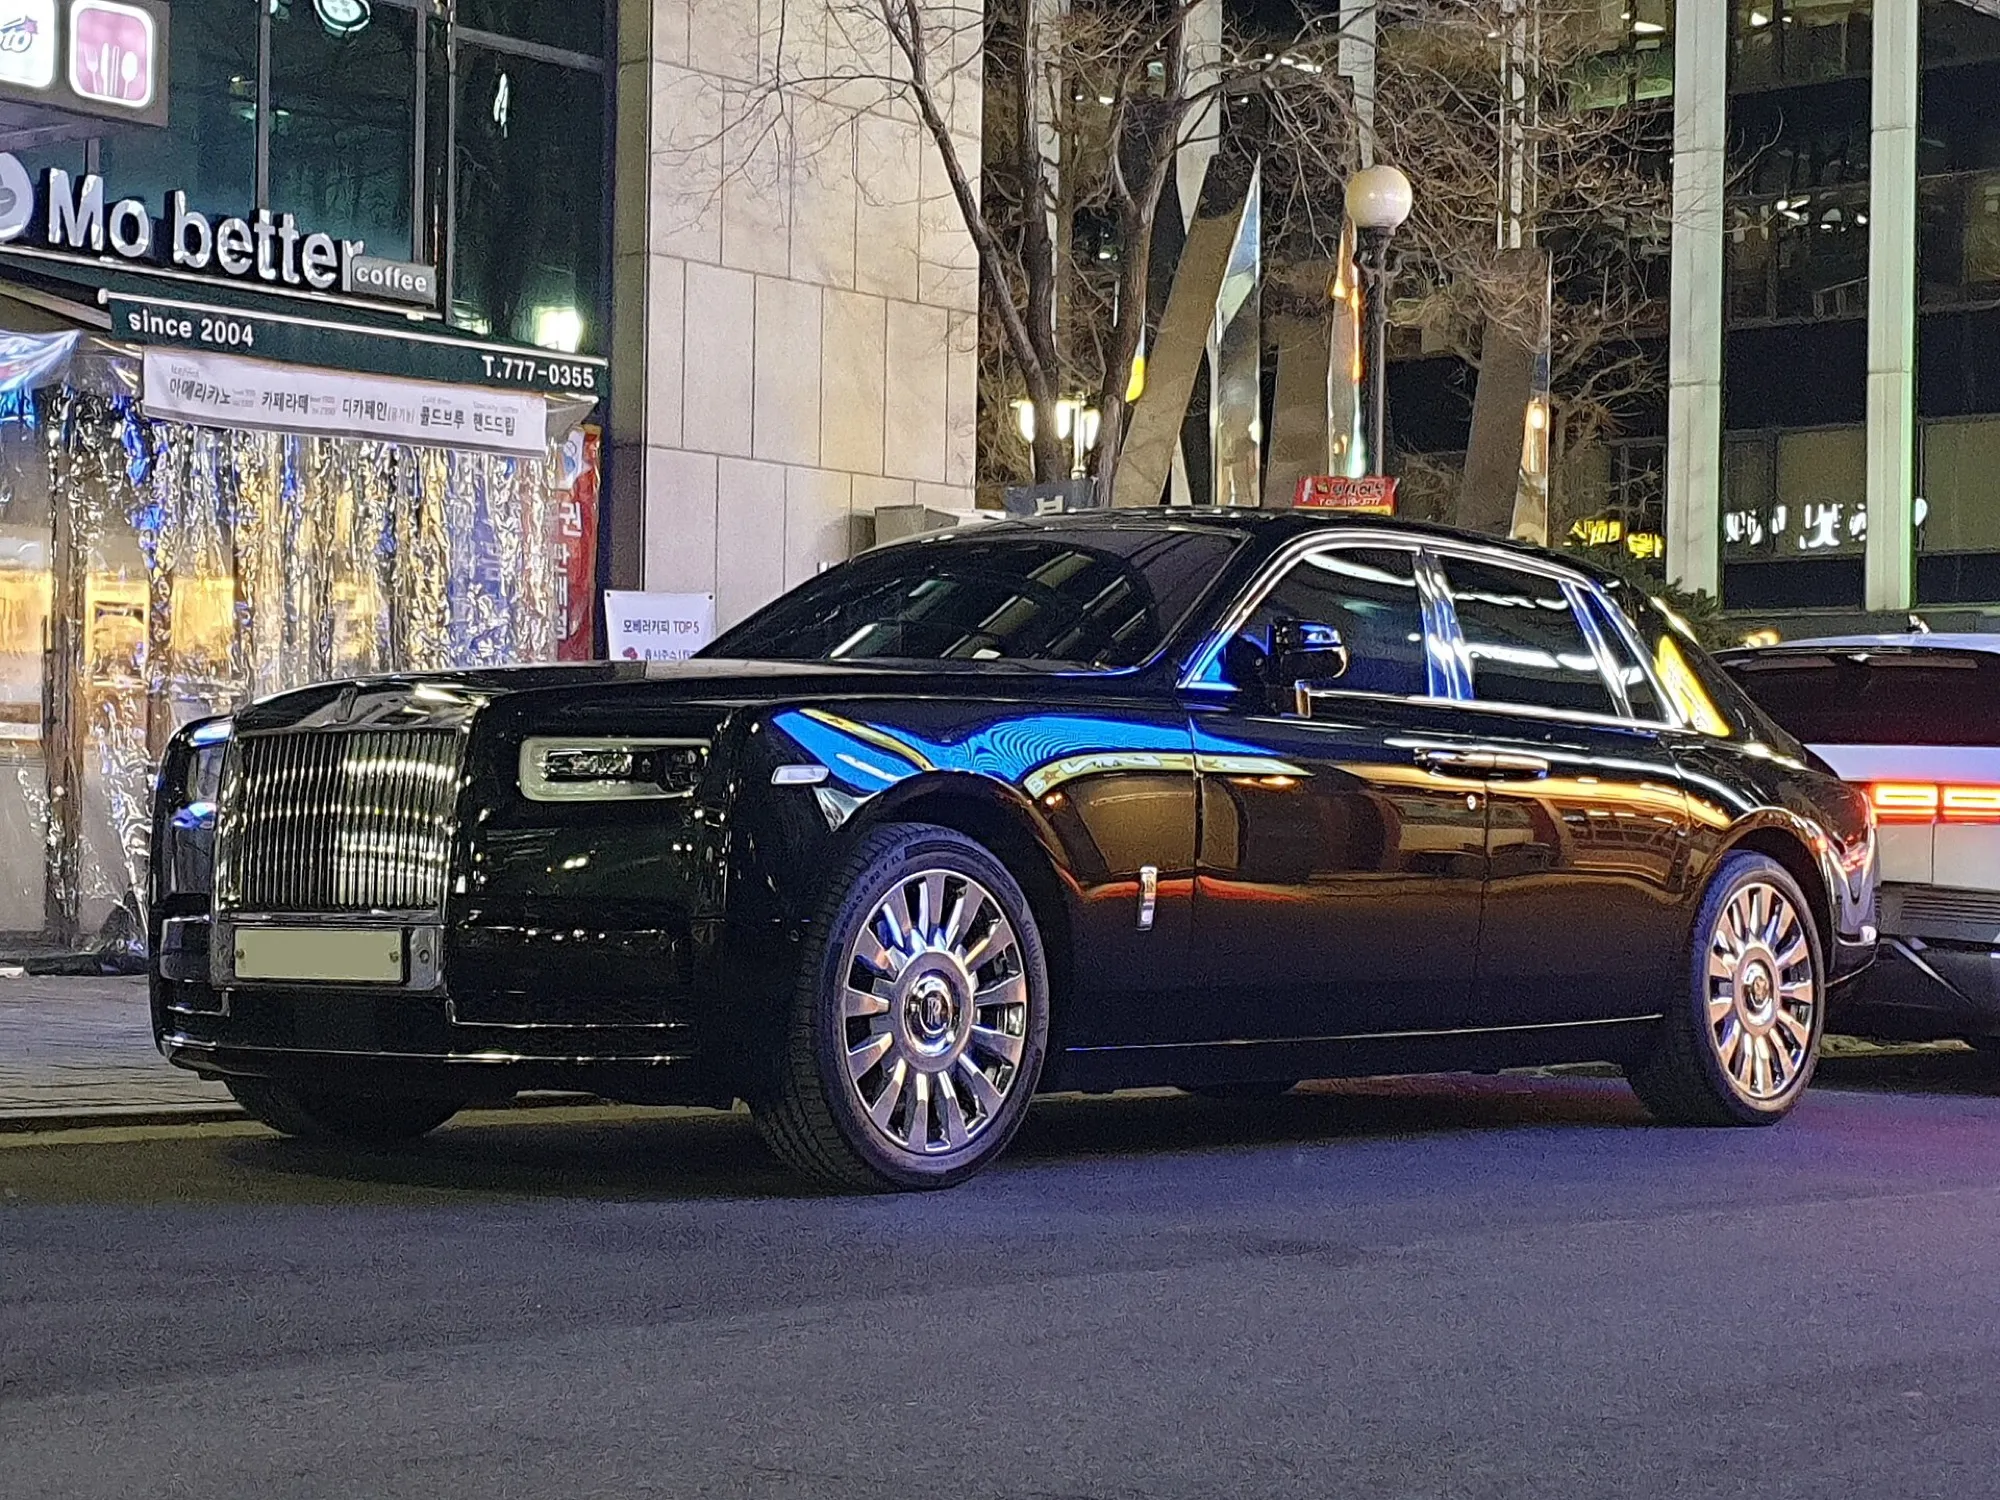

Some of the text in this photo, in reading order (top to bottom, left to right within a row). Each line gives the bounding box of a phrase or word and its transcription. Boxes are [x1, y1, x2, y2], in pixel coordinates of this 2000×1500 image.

[48, 168, 365, 292] Mo better
[356, 266, 427, 292] coffee
[128, 308, 254, 347] since 2004
[481, 355, 594, 388] T.777-0355
[169, 376, 231, 406] 아메리카노
[420, 405, 465, 430] 콜드브루
[473, 411, 516, 436] 핸드드립
